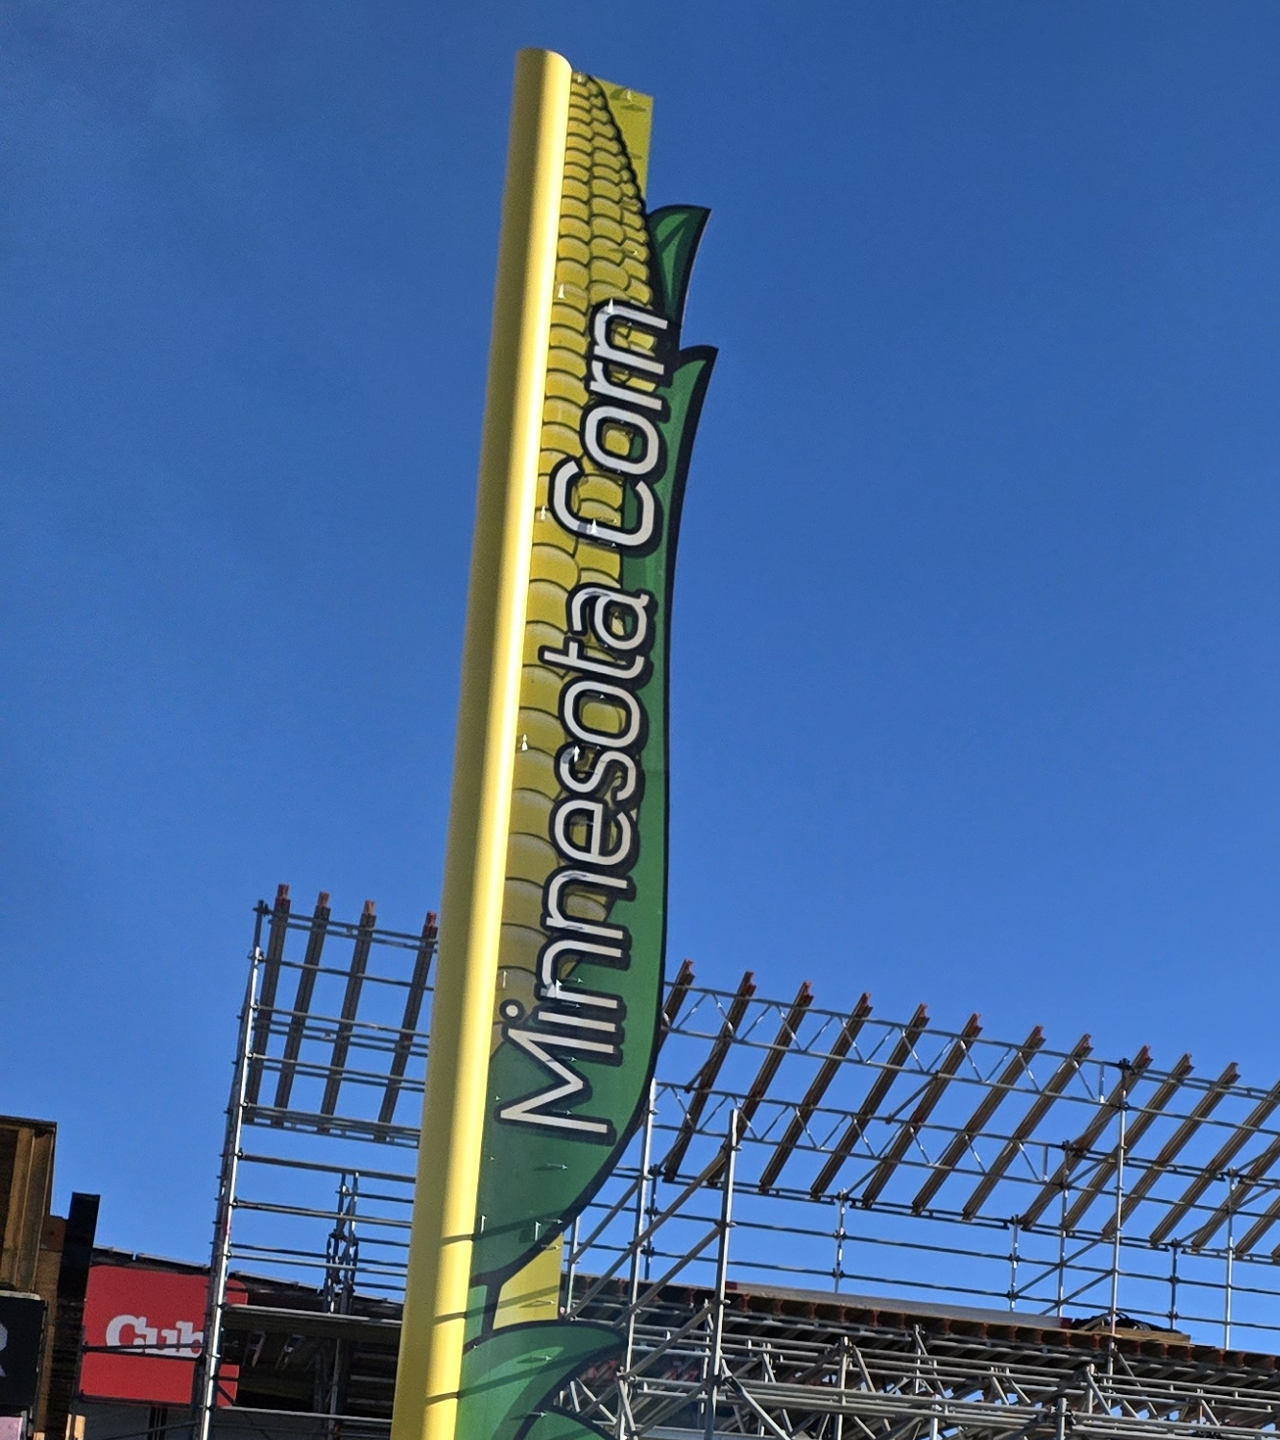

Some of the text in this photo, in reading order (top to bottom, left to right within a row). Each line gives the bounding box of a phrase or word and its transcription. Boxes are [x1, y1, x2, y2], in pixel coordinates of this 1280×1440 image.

[499, 299, 669, 1134] Minnesota Corn
[105, 1313, 205, 1359] Cub
